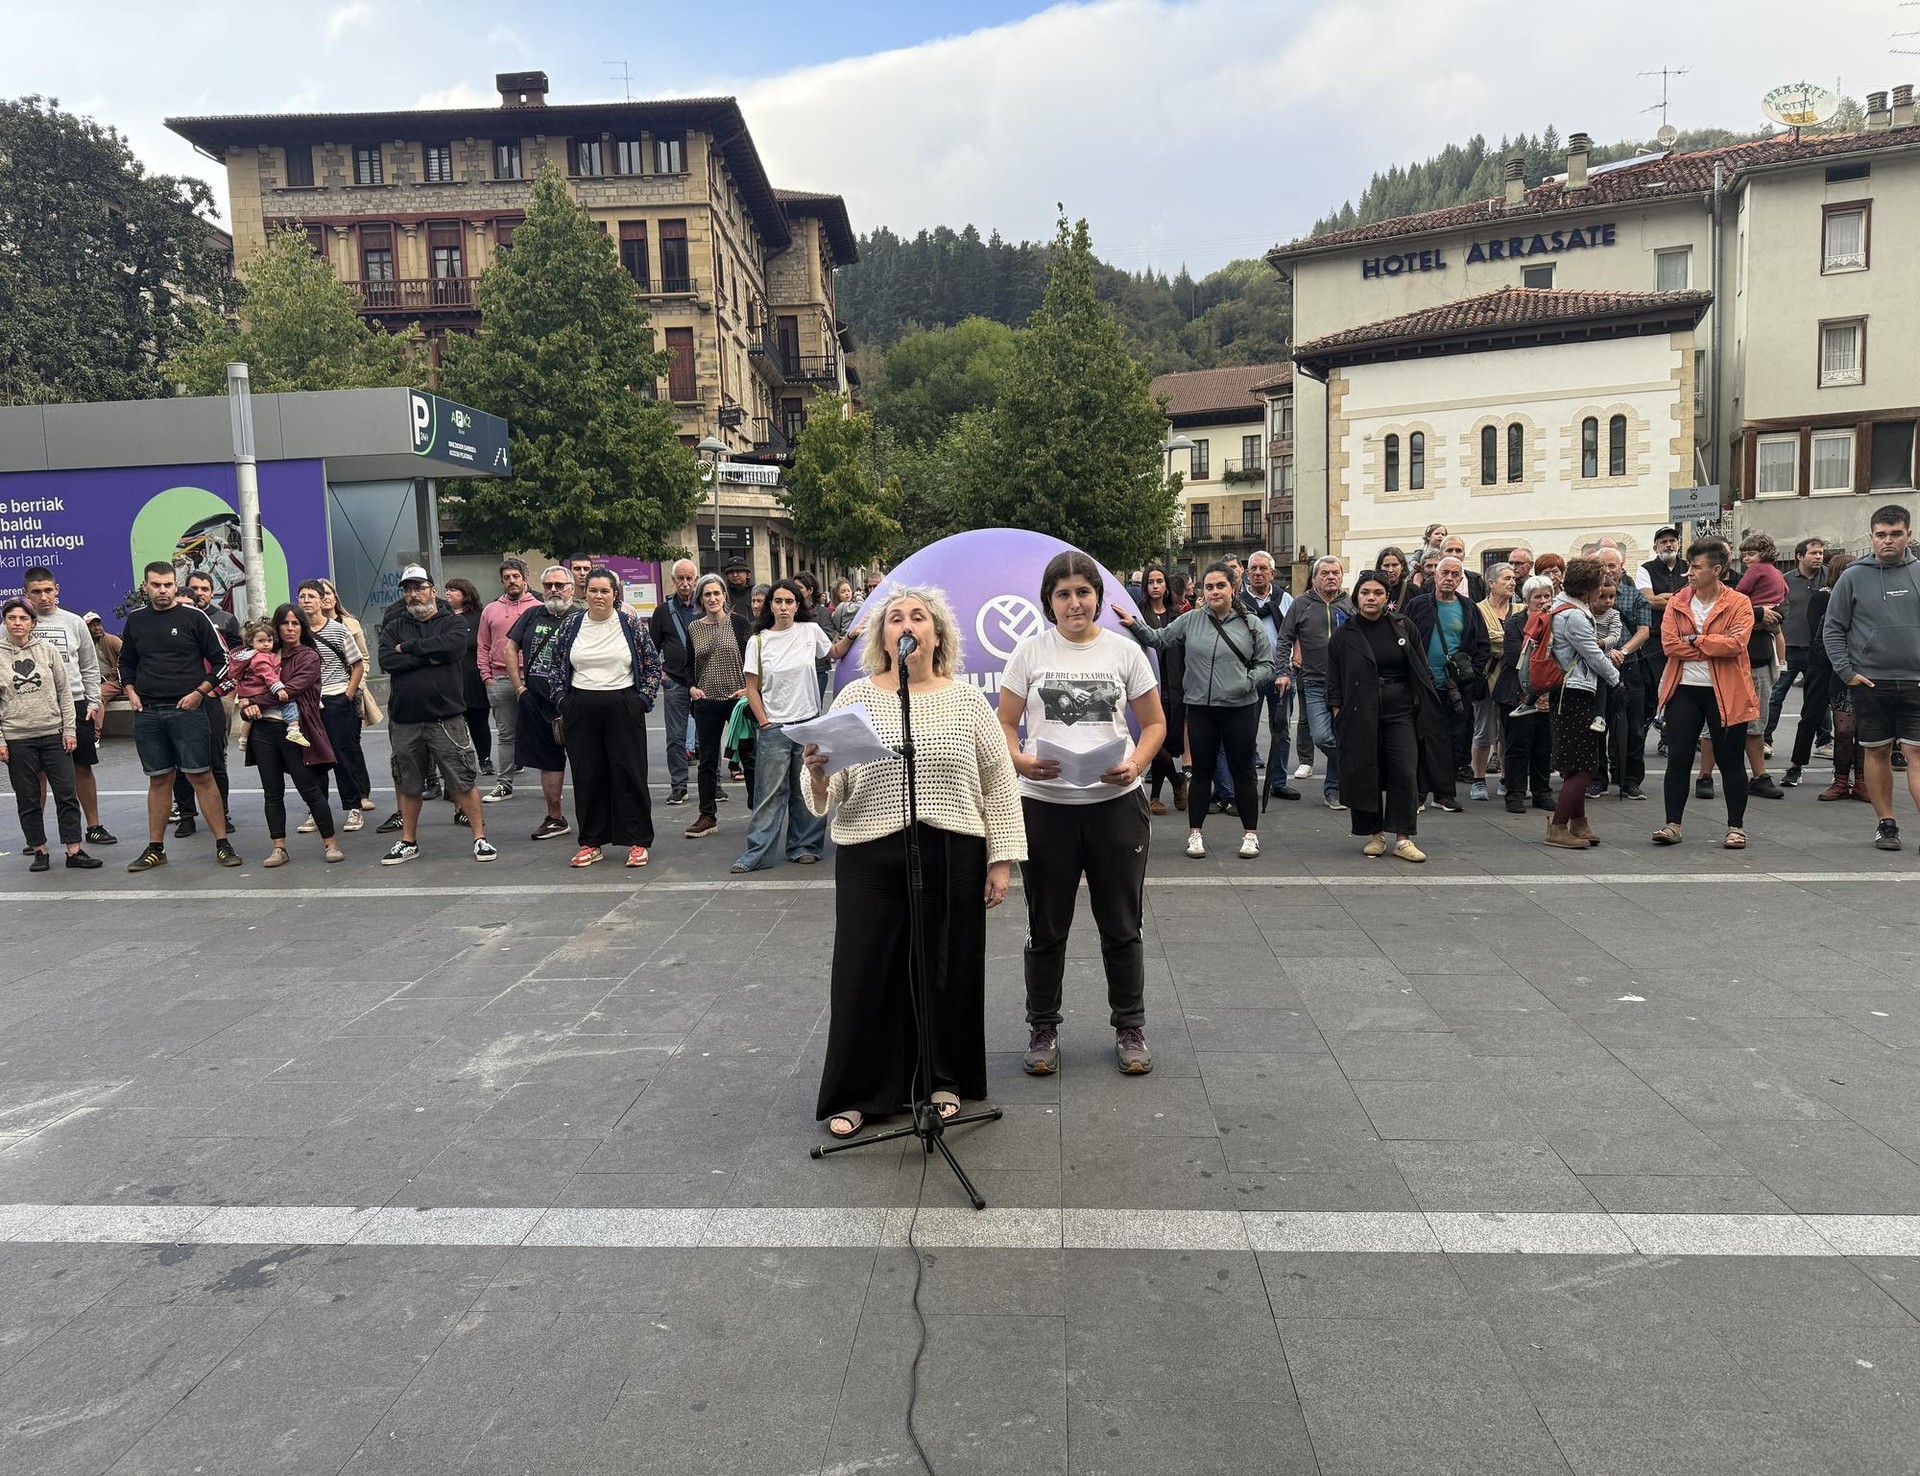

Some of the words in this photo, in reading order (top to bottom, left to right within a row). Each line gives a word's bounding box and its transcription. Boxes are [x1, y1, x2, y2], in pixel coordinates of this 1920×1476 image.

[1763, 84, 1828, 105] ARRASATE
[1774, 98, 1815, 111] HOTEL
[1362, 248, 1447, 280] HOTEL
[1466, 223, 1616, 265] ARRASATE
[412, 395, 430, 445] P
[11, 496, 64, 513] berriak
[21, 533, 84, 550] dizkiogu
[0, 551, 63, 568] karlanari.
[1045, 671, 1069, 679] BERRI
[1080, 672, 1114, 680] TXARRAK
